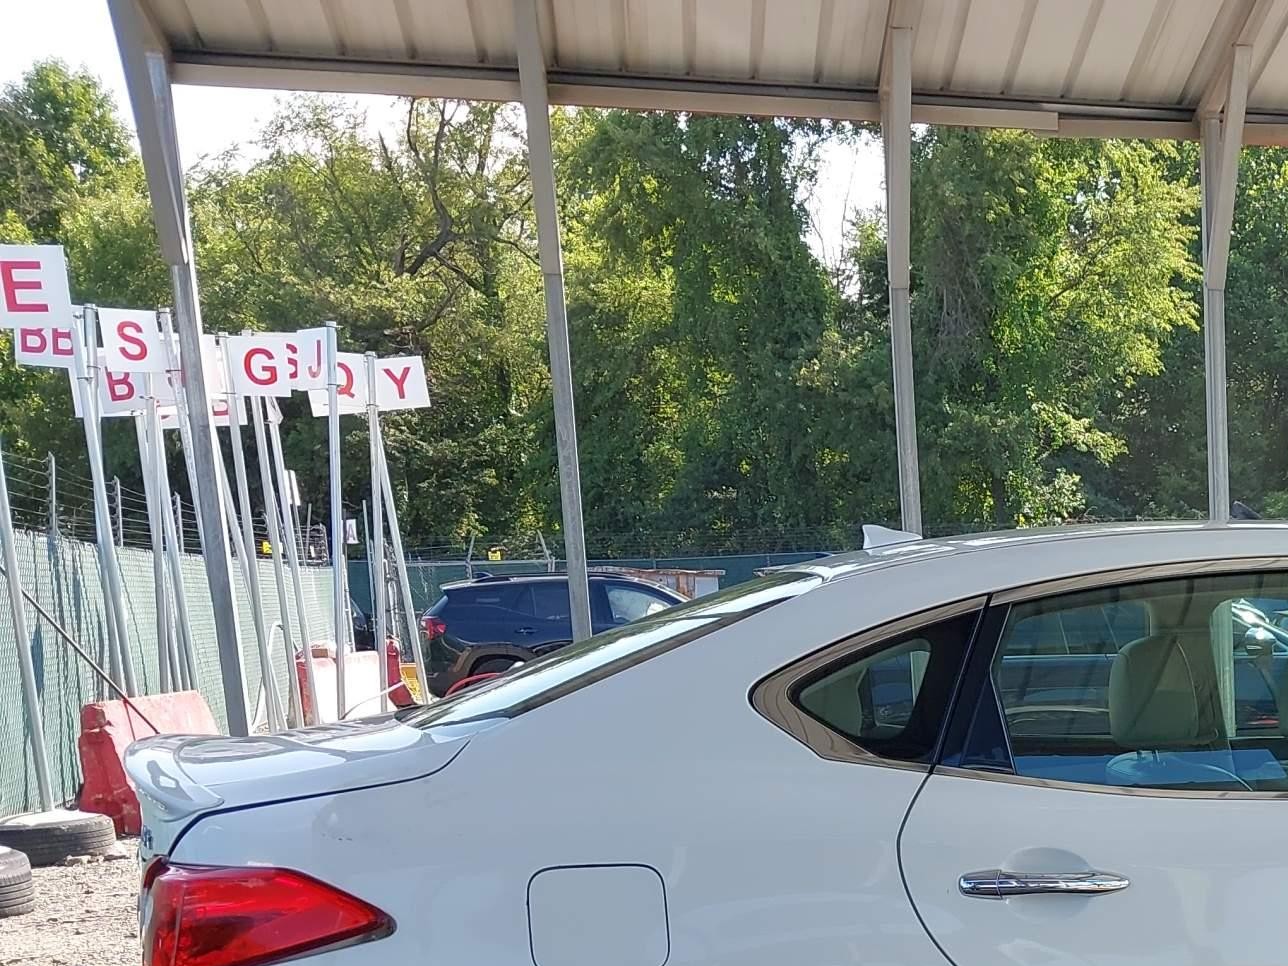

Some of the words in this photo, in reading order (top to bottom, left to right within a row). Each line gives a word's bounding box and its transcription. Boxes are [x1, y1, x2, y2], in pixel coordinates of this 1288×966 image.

[0, 260, 49, 313] E
[117, 320, 148, 362] S
[307, 339, 322, 378] J
[243, 347, 279, 386] G
[383, 366, 410, 399] Y
